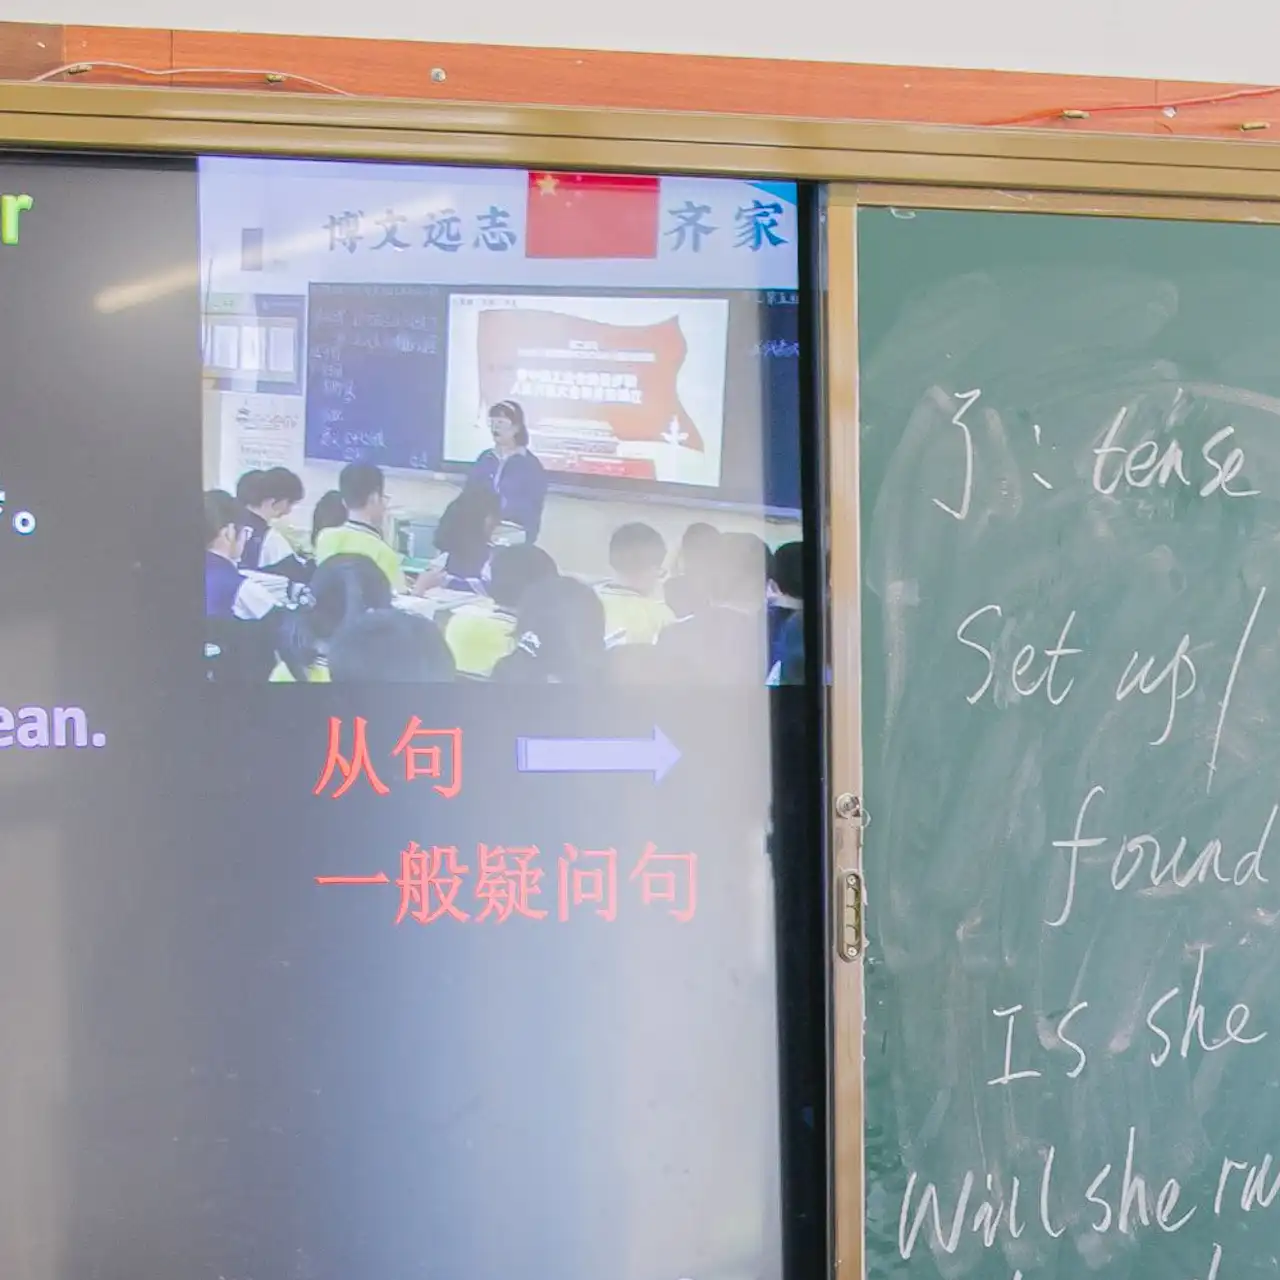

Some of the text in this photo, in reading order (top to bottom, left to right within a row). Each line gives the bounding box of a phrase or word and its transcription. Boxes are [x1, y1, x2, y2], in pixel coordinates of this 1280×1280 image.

[664, 200, 791, 253] 齐家
[1091, 406, 1262, 498] tense
[956, 604, 1083, 705] Set
[312, 716, 465, 799] 从句
[313, 841, 700, 925] 一般疑问句
[1044, 786, 1280, 927] found
[987, 1001, 1090, 1086] Is
[1150, 947, 1268, 1068] she
[1084, 1126, 1198, 1236] she
